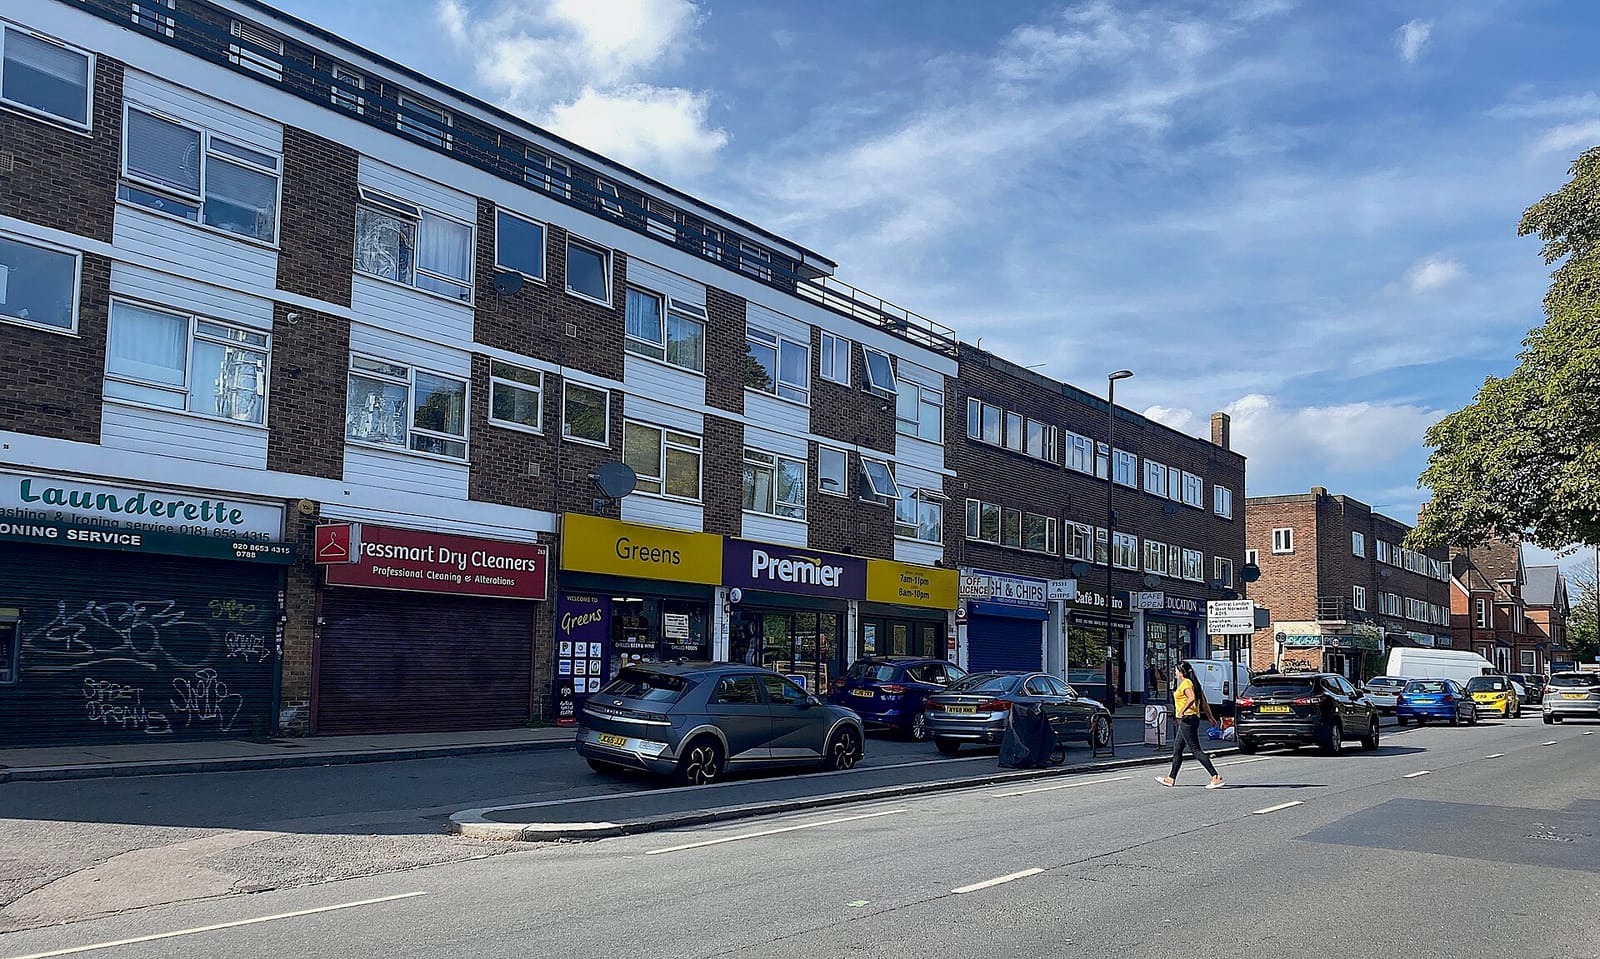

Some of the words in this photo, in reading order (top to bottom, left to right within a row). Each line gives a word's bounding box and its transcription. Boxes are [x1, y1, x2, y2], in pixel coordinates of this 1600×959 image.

[20, 479, 244, 525] Launderette
[54, 511, 64, 521] &
[72, 513, 119, 527] Ironing
[126, 521, 174, 534] service
[180, 525, 208, 536] 0181
[213, 528, 237, 539] 653
[242, 531, 270, 541] 4315
[66, 529, 141, 546] SERVICE
[236, 551, 257, 559] 0788
[250, 544, 269, 552] 8653
[271, 546, 290, 554] 4315
[360, 542, 435, 563] ressmart
[438, 547, 467, 570] Dry
[471, 551, 536, 572] Cleaners
[615, 537, 681, 565] Greens
[372, 566, 424, 579] Professional
[426, 571, 462, 583] Cleaning
[474, 575, 515, 586] Alterations
[752, 549, 843, 587] Premier
[900, 574, 930, 586] 7am-11pm
[966, 577, 982, 586] OFF
[898, 588, 930, 600] 8am-10pm
[960, 585, 988, 595] LICENCE
[1005, 583, 1014, 597] &
[1016, 584, 1043, 601] CHIPS
[1075, 591, 1092, 605] Café
[561, 608, 602, 635] Greens
